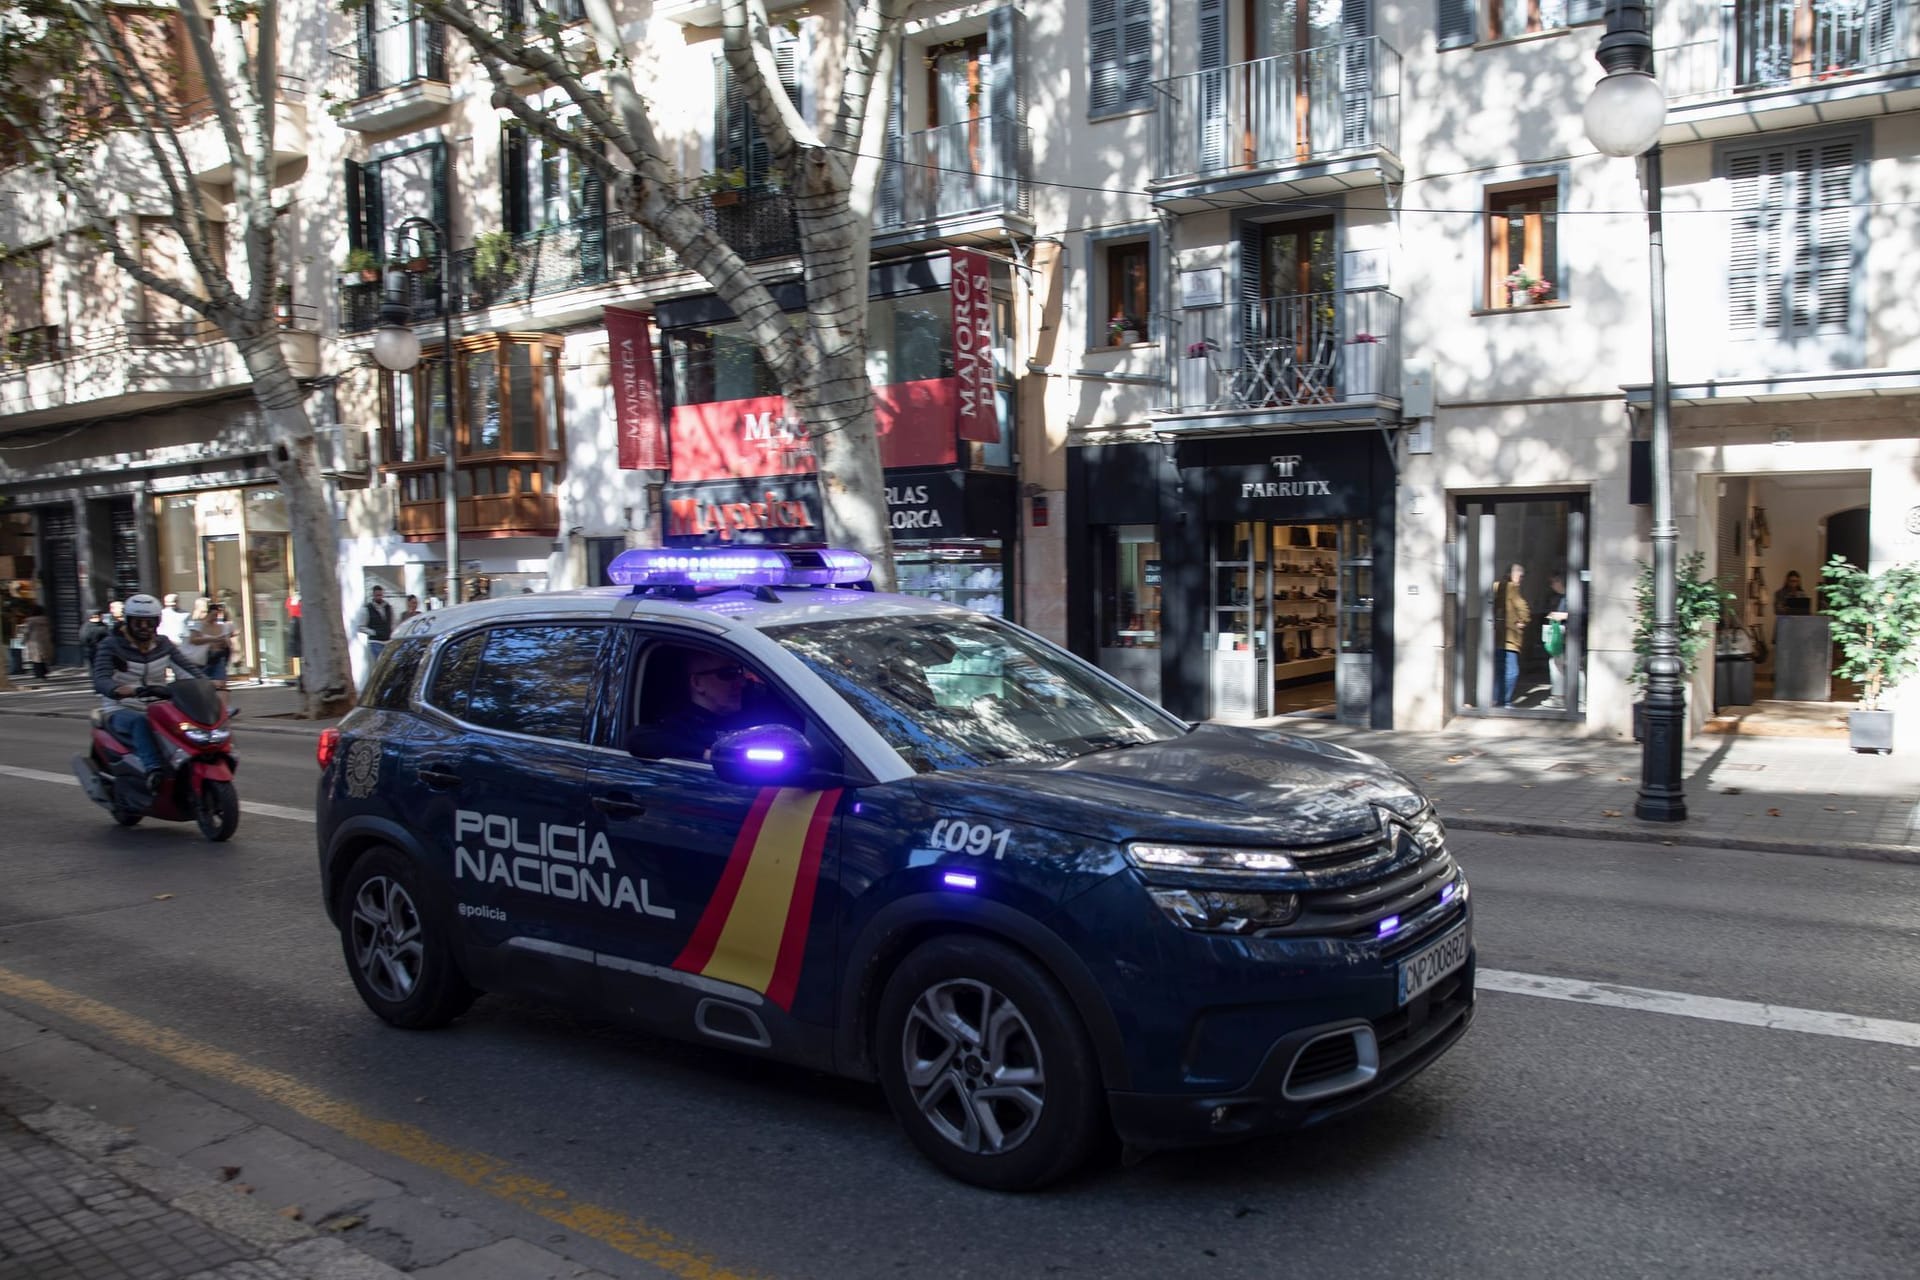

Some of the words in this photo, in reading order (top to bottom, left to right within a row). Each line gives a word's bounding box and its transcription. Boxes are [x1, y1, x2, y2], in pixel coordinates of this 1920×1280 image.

[952, 256, 977, 416] MAJORCA
[973, 275, 993, 406] PEARLS
[455, 809, 616, 868] POLICÍA
[455, 846, 676, 919] NACIONAL
[458, 902, 507, 921] @policia
